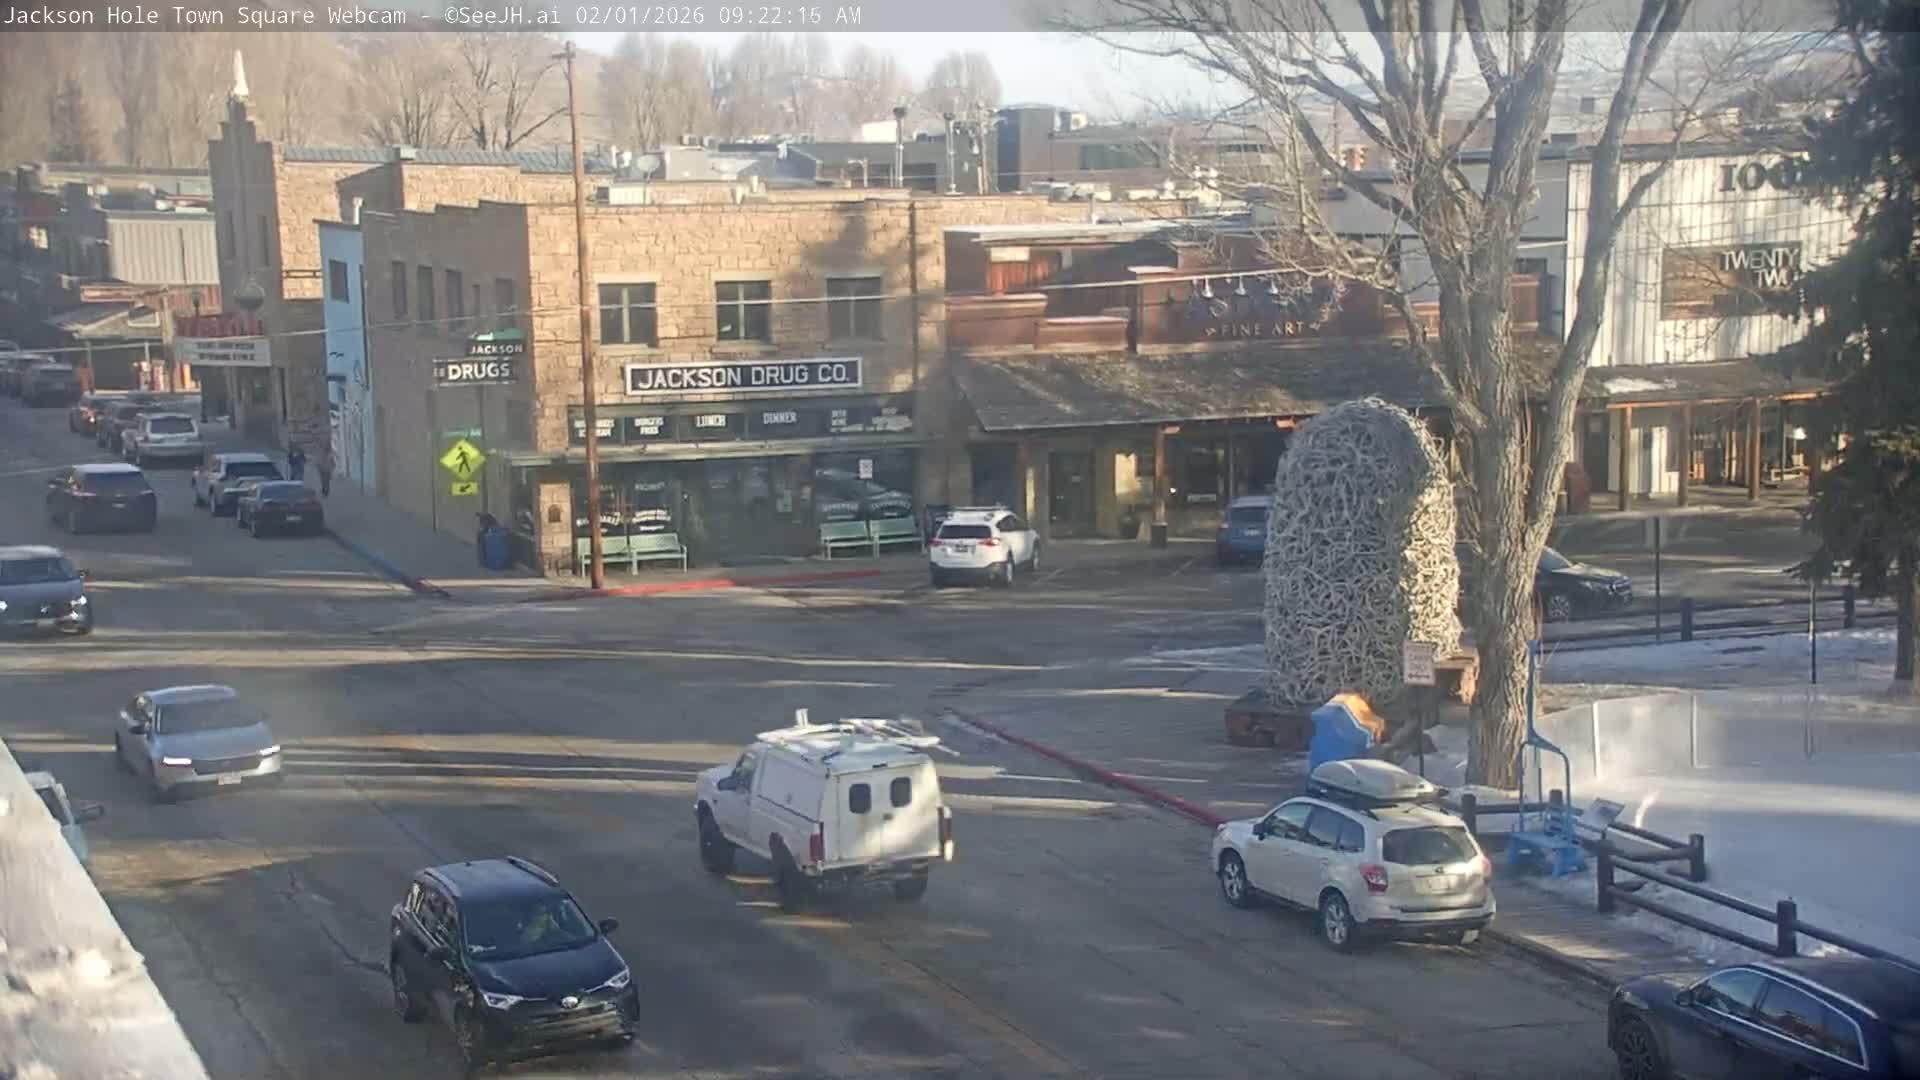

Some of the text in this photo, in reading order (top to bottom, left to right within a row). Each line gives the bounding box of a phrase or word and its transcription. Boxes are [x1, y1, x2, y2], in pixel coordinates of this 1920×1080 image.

[1722, 247, 1799, 271] TWENTY
[1221, 321, 1304, 336] FINE ART
[471, 345, 523, 354] JACKSON
[448, 362, 511, 381] DRUGS
[637, 362, 851, 390] JACKSON DRUG CO.
[696, 414, 727, 428] LUNCH
[763, 411, 798, 425] DINNER
